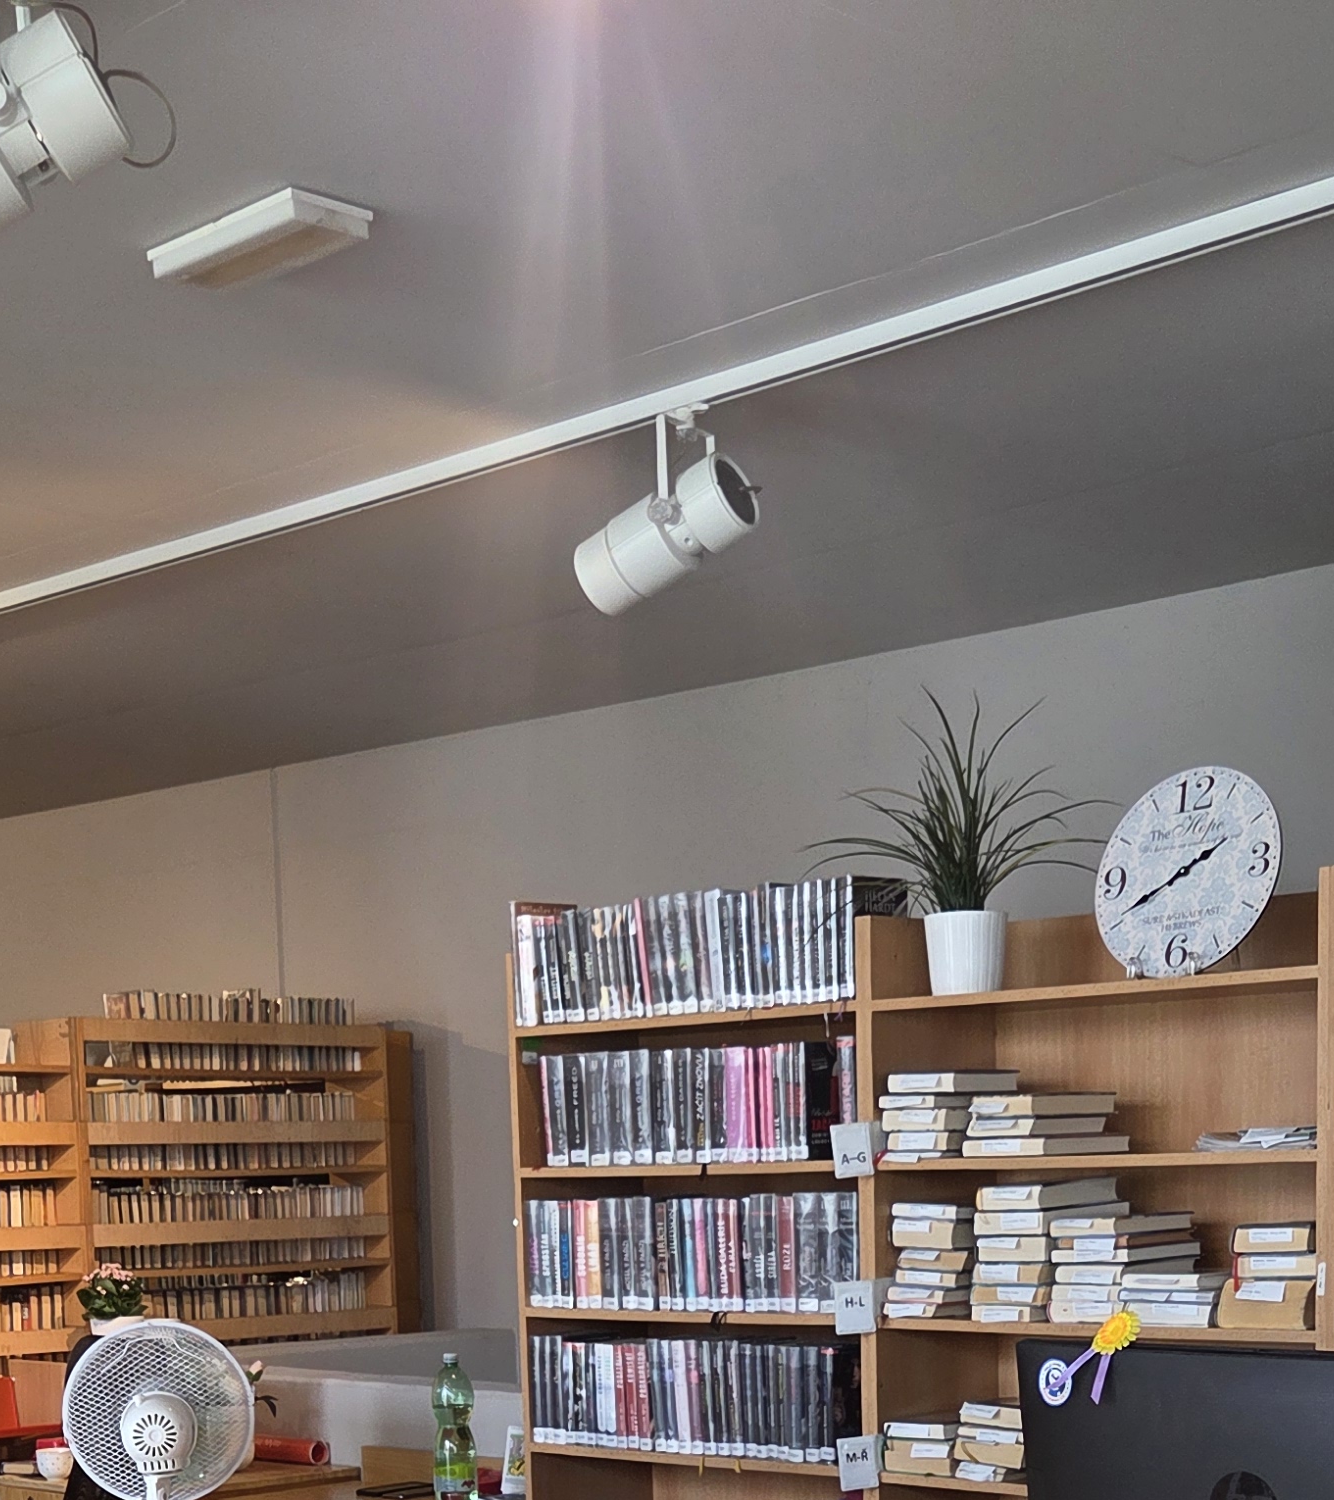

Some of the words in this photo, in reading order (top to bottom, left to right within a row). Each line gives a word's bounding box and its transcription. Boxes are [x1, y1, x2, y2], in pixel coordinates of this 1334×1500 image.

[1174, 775, 1215, 814] 12
[1151, 830, 1171, 842] The
[1173, 812, 1225, 844] Hope
[1248, 841, 1271, 878] 3
[1103, 866, 1127, 900] 9
[1164, 933, 1188, 968] 6
[695, 1053, 704, 1089] ZNOVU
[695, 1090, 704, 1121] ZAČÍT
[845, 1295, 866, 1309] H-L
[845, 1448, 869, 1464] M-Ř
